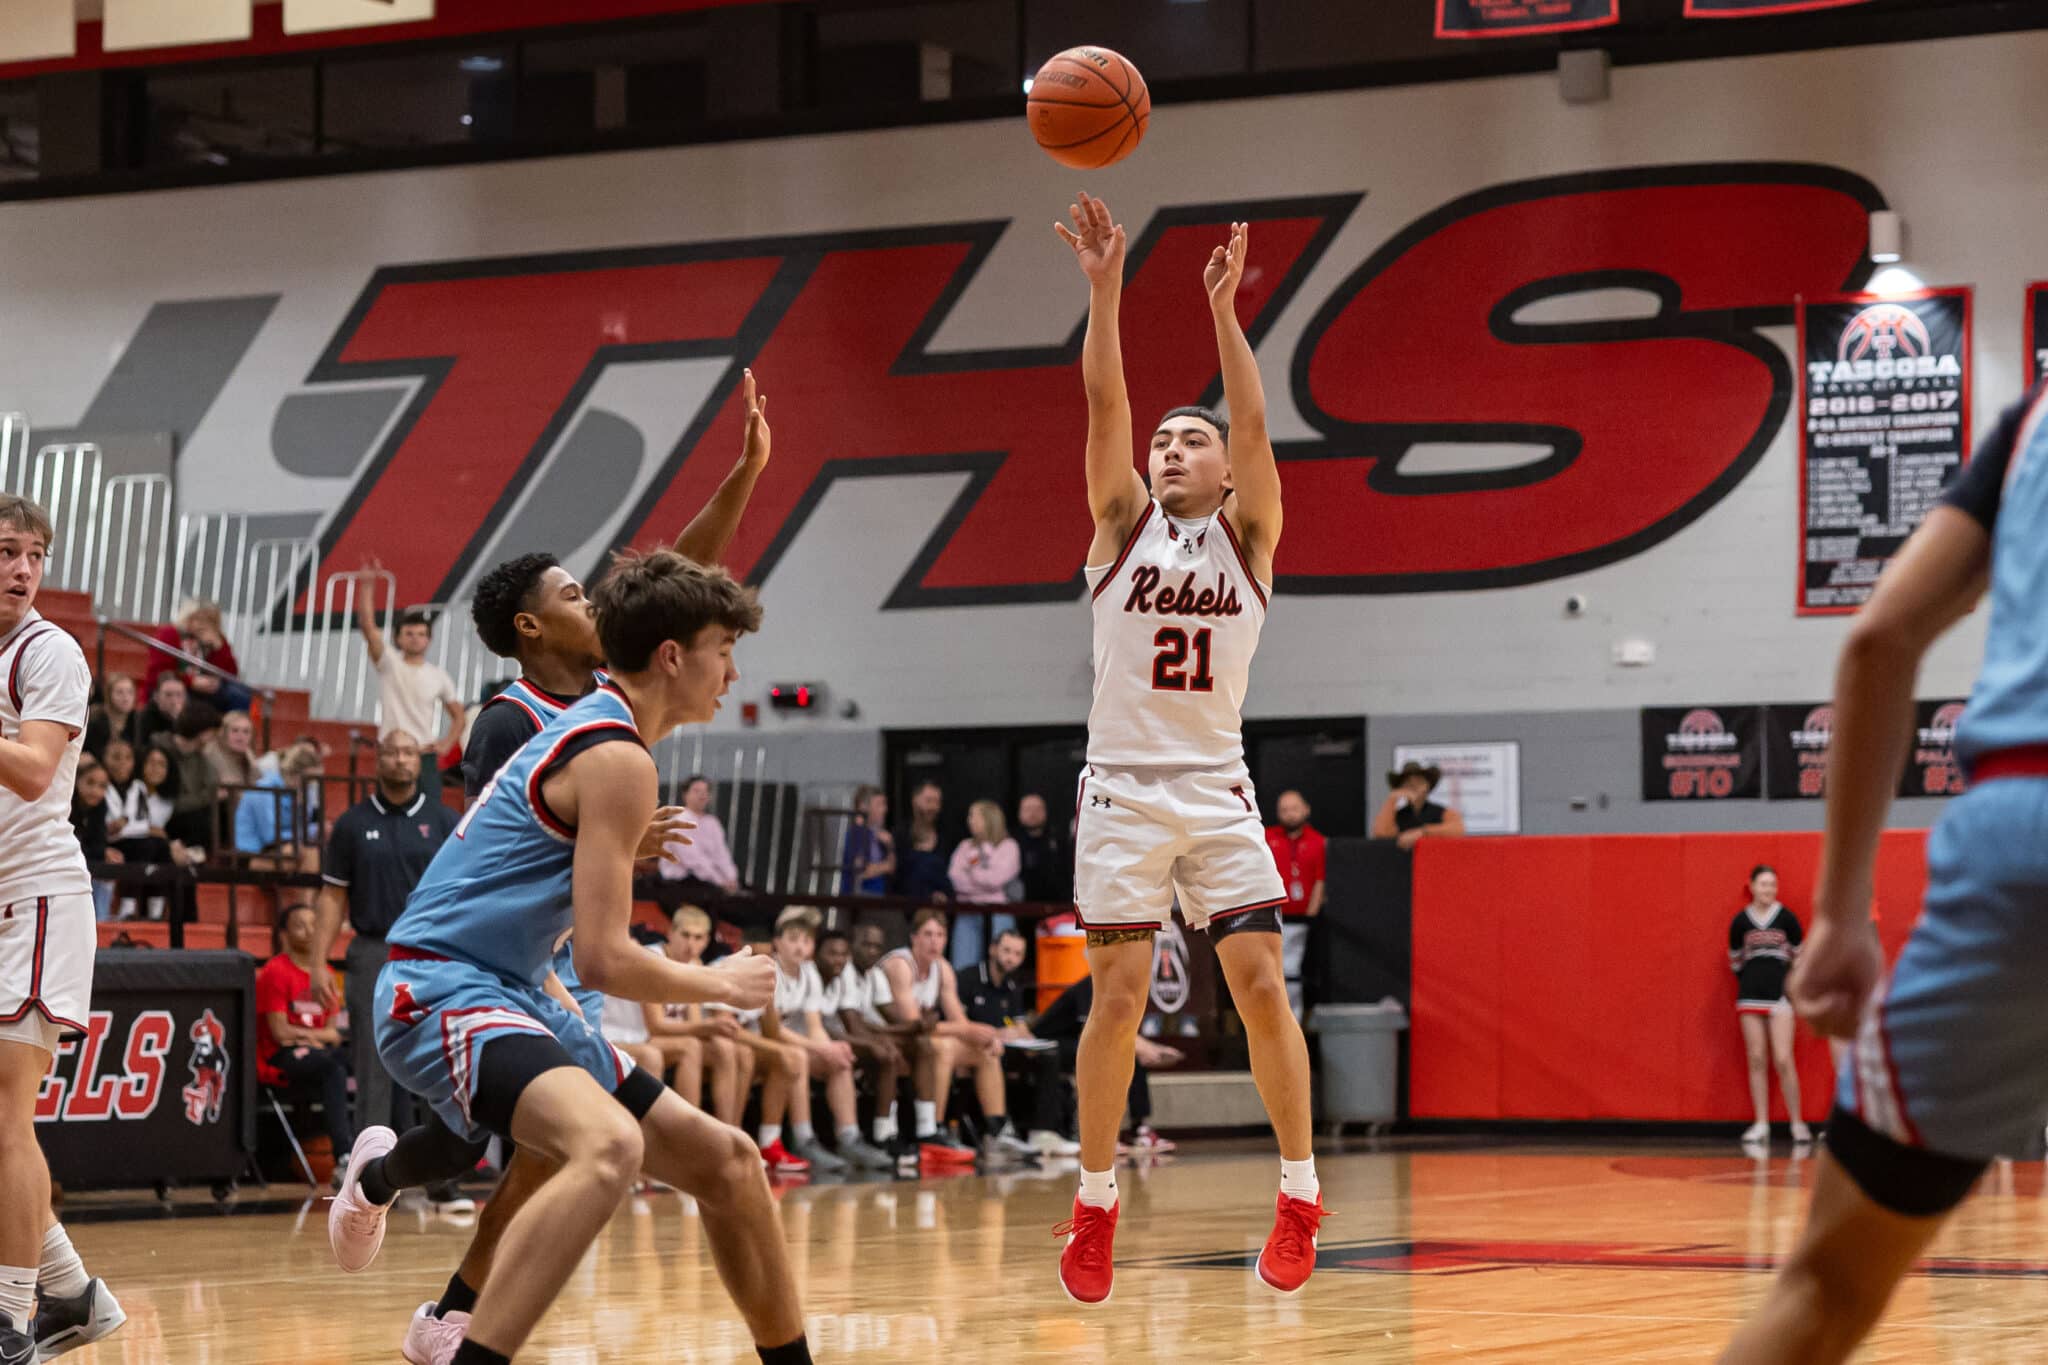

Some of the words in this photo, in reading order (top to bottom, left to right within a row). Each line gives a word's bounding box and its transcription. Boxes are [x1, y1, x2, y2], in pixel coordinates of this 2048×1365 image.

[1807, 354, 1961, 383] TASCOSA
[258, 162, 1889, 632] THS
[1809, 390, 1959, 416] 2016-2017
[1124, 565, 1242, 616] Rebels
[1152, 626, 1214, 692] 21
[1670, 768, 1733, 798] #10
